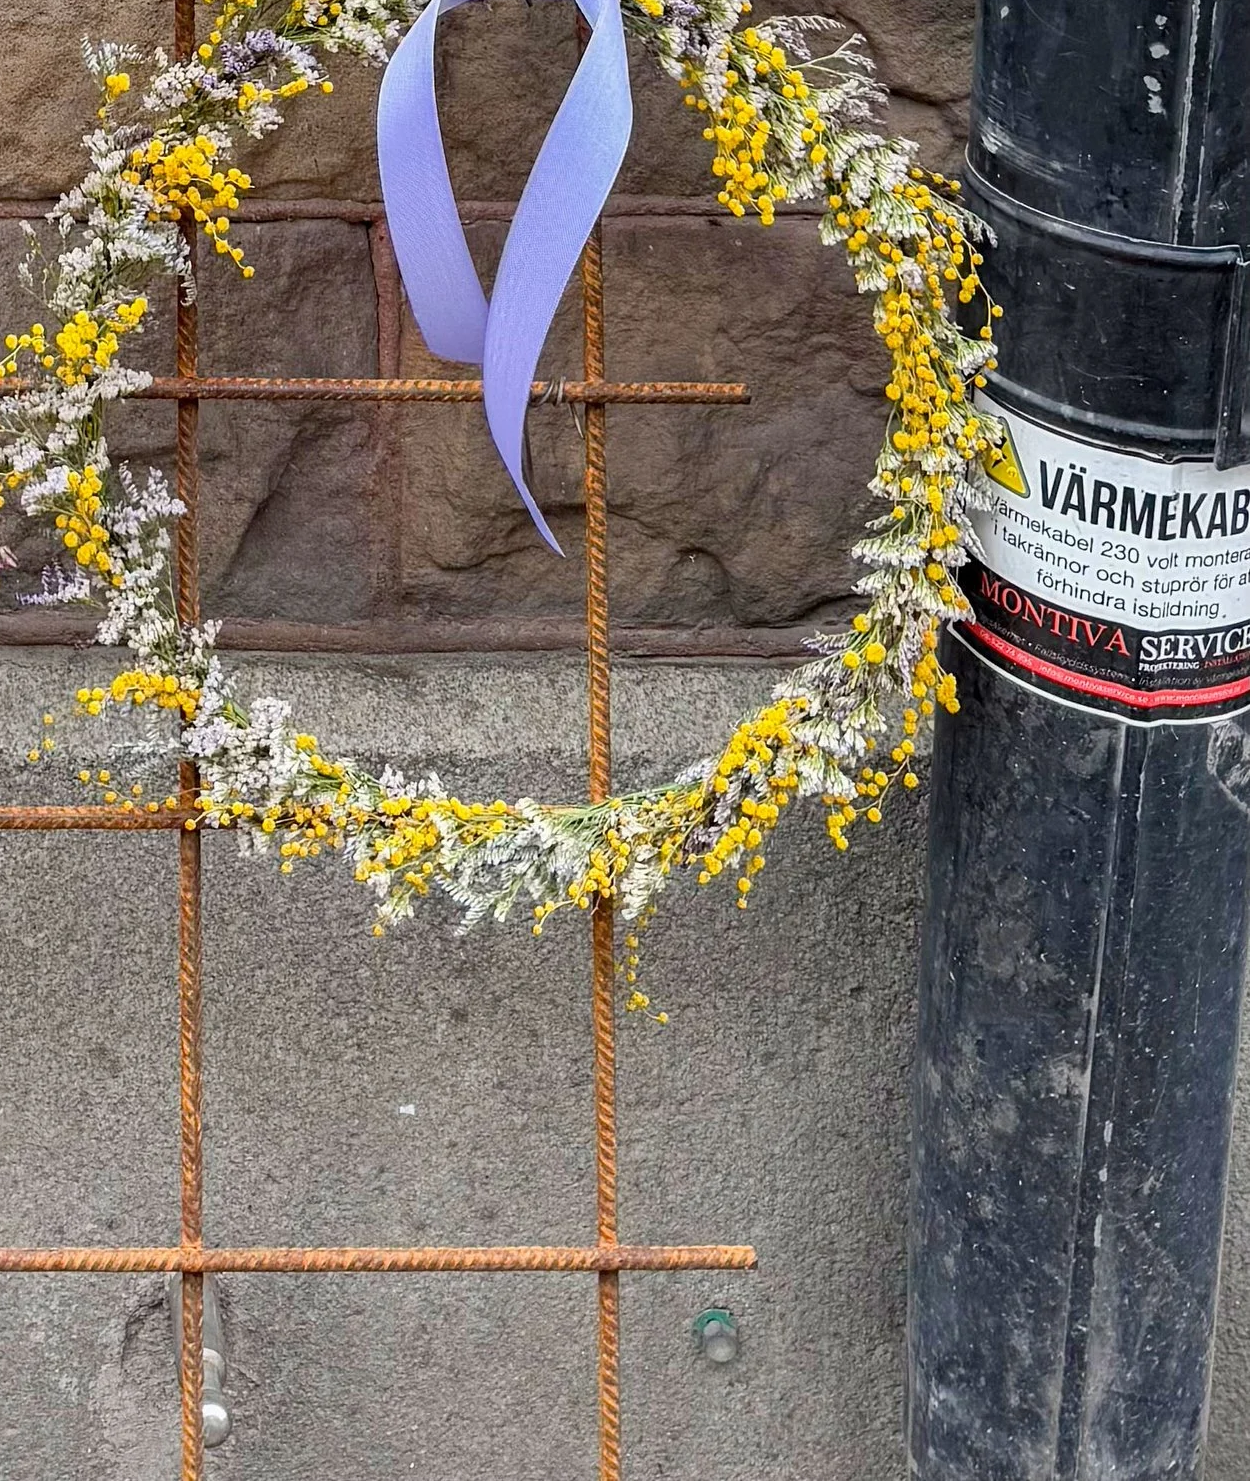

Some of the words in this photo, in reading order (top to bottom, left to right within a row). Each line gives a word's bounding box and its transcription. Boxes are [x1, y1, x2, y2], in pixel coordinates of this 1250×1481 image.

[1039, 459, 1250, 541] VÄRMEKAB
[993, 519, 999, 535] i
[1002, 526, 1091, 576] takrännor
[1096, 569, 1134, 588] och
[1141, 576, 1209, 596] stuprör
[1213, 573, 1235, 591] för
[1036, 568, 1127, 611] förhindra
[1132, 597, 1228, 619] isbildning.
[1100, 541, 1140, 564] 230
[1147, 552, 1179, 570] volt
[980, 571, 1132, 658] MONTIVA
[1139, 625, 1250, 661] SERVICE
